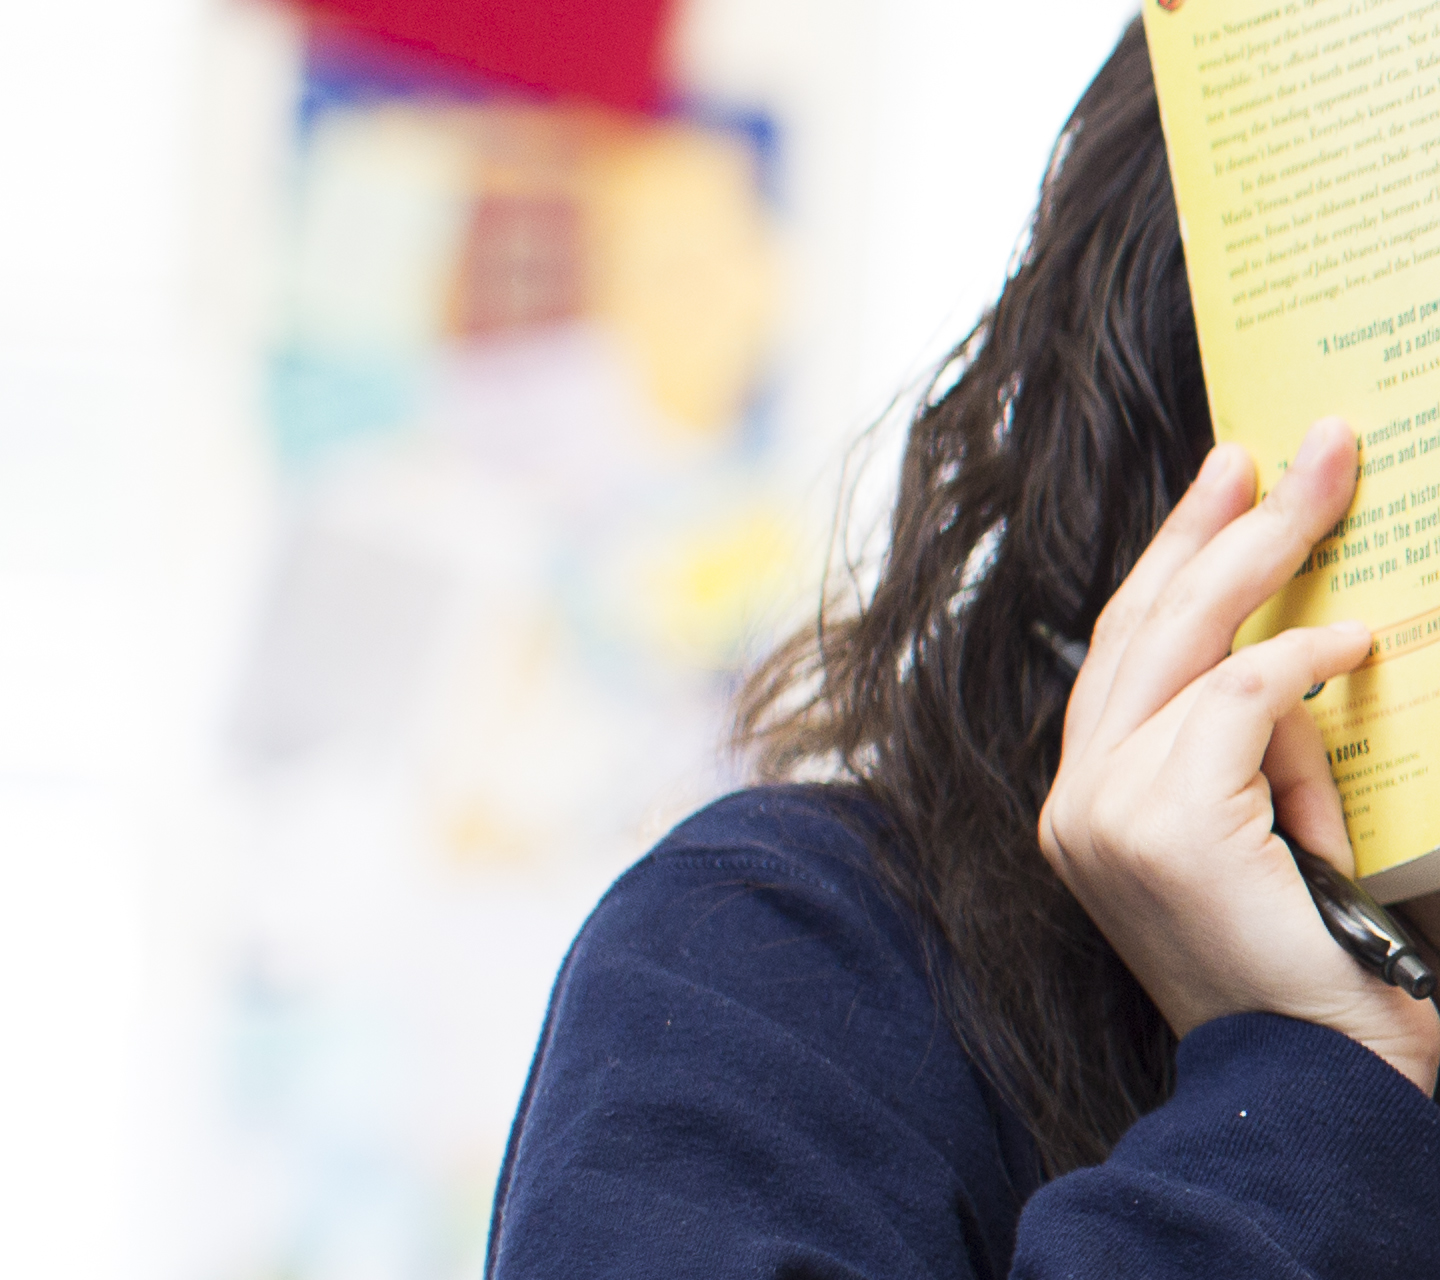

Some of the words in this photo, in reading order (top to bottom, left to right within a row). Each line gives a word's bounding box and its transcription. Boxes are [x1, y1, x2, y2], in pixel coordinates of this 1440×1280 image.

[1333, 317, 1394, 351] fascinating
[1396, 305, 1416, 328] and
[1382, 340, 1402, 362] and
[1405, 340, 1410, 354] a
[1401, 357, 1439, 383] DALLAS
[1366, 417, 1411, 447] sensitive
[1414, 402, 1440, 427] novel
[1397, 442, 1415, 464] and
[1387, 493, 1406, 516] and
[1315, 542, 1339, 571] this
[1342, 536, 1368, 559] book
[1373, 530, 1389, 550] for
[1393, 523, 1410, 542] the
[1414, 506, 1440, 534] novel
[1329, 575, 1340, 592] it
[1342, 566, 1374, 588] takes
[1377, 558, 1401, 580] you.
[1404, 541, 1430, 565] Read
[1395, 624, 1422, 648] GUIDE
[1334, 739, 1370, 763] BOOKS
